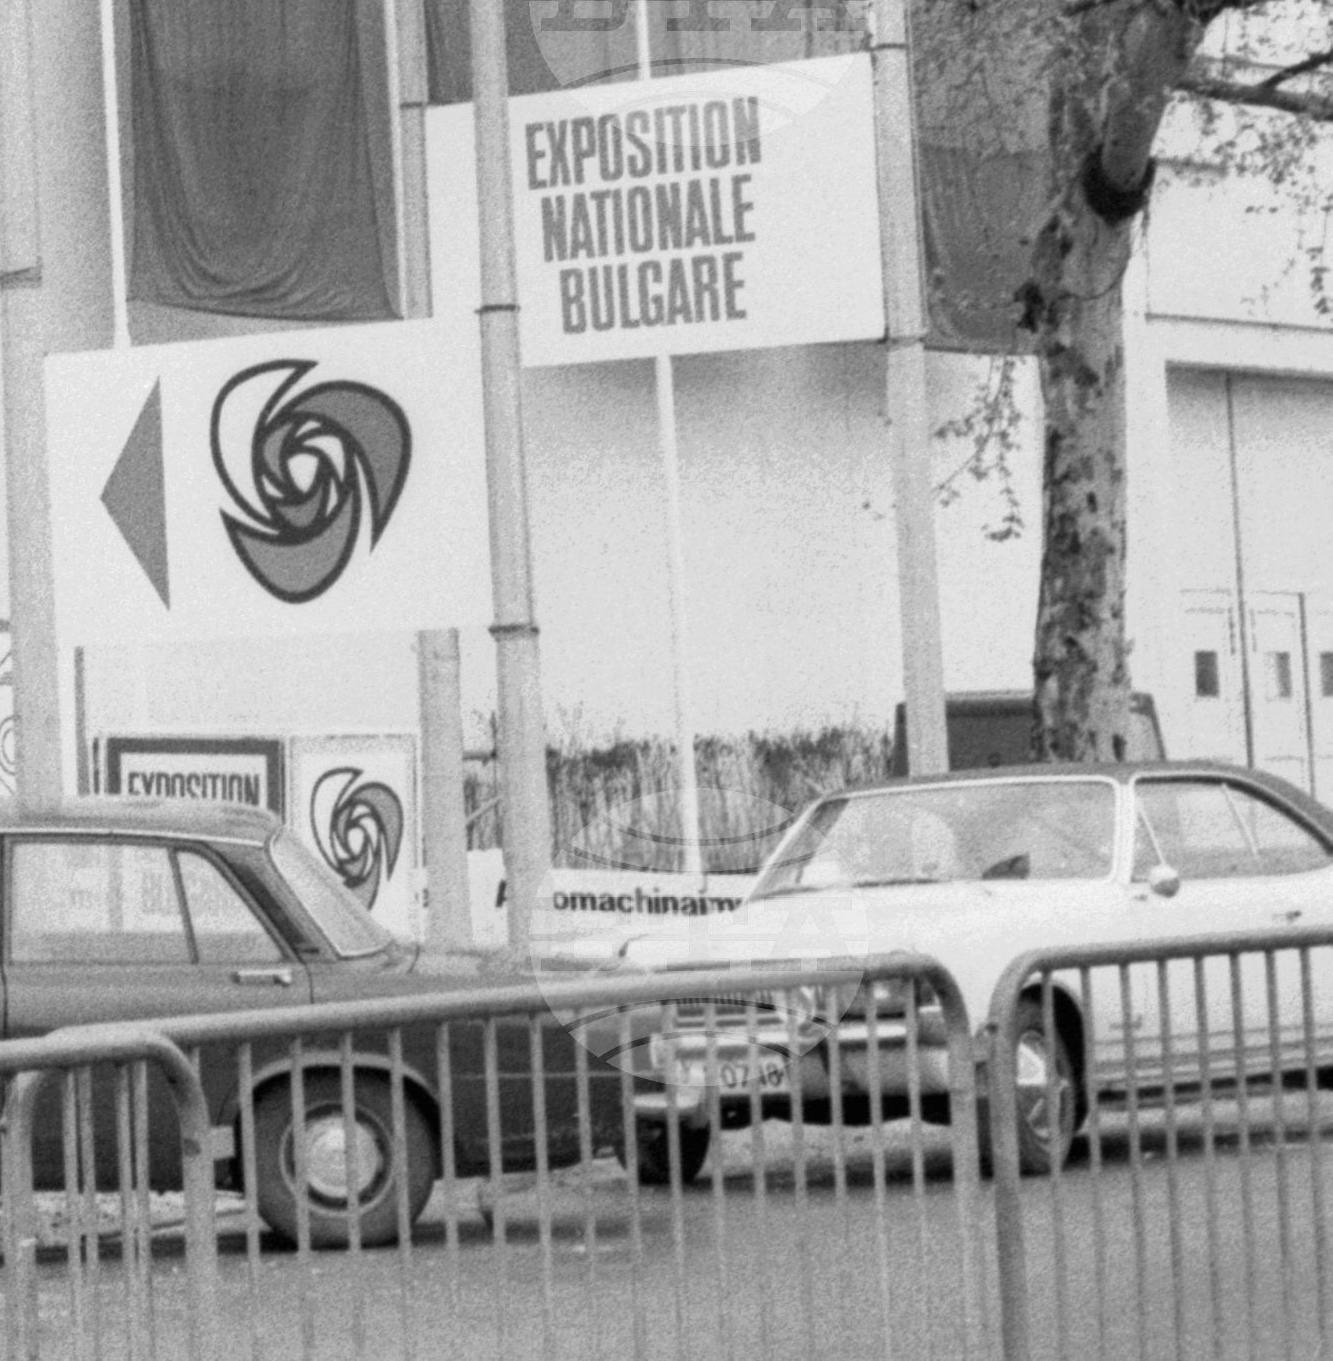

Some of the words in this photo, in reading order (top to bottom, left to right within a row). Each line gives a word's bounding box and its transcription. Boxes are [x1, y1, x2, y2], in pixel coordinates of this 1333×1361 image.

[525, 96, 762, 191] EXPOSITION
[540, 173, 757, 264] NATIONALE
[559, 251, 748, 335] BULGARE
